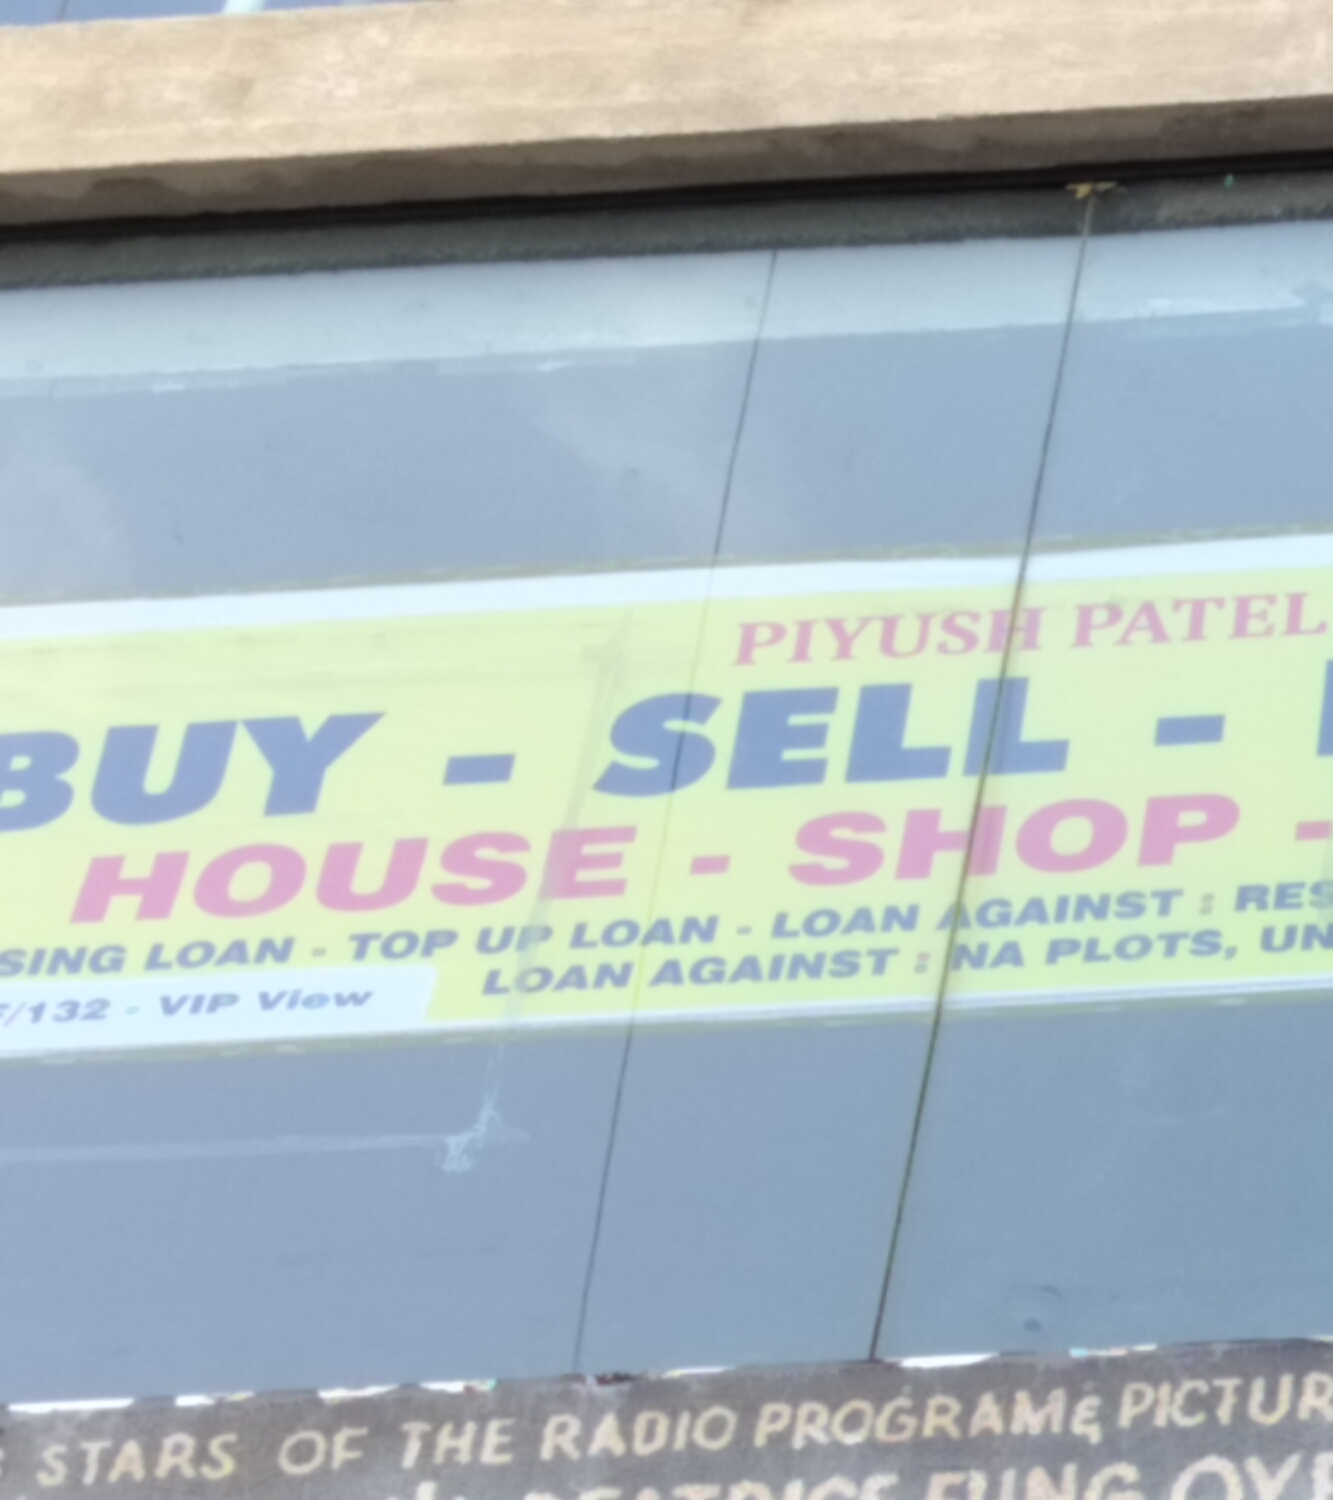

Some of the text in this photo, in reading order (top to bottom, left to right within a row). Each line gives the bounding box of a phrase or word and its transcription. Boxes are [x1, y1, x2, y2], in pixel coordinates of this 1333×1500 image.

[731, 605, 1048, 666] PIYUSH
[1069, 591, 1328, 648] PATEL
[0, 710, 386, 832] BUY
[592, 676, 1070, 797] SELL
[69, 826, 638, 924] HOUSE
[788, 793, 1241, 886] SHOP
[144, 936, 295, 972] LOAN
[348, 929, 458, 961] TOP
[475, 924, 554, 956] UP
[568, 915, 719, 951] LOAN
[770, 904, 921, 940] LOAN
[935, 889, 1184, 930] AGAINST
[481, 961, 634, 997] LOAN
[648, 948, 899, 987] AGAINST
[949, 940, 1026, 972] NA
[1045, 928, 1238, 967] PLOTS,
[159, 993, 240, 1016] VIP
[258, 990, 373, 1011] View
[36, 1432, 238, 1486] STARS
[278, 1427, 368, 1476] OF
[400, 1418, 516, 1469] THE
[539, 1405, 736, 1461] RADIO
